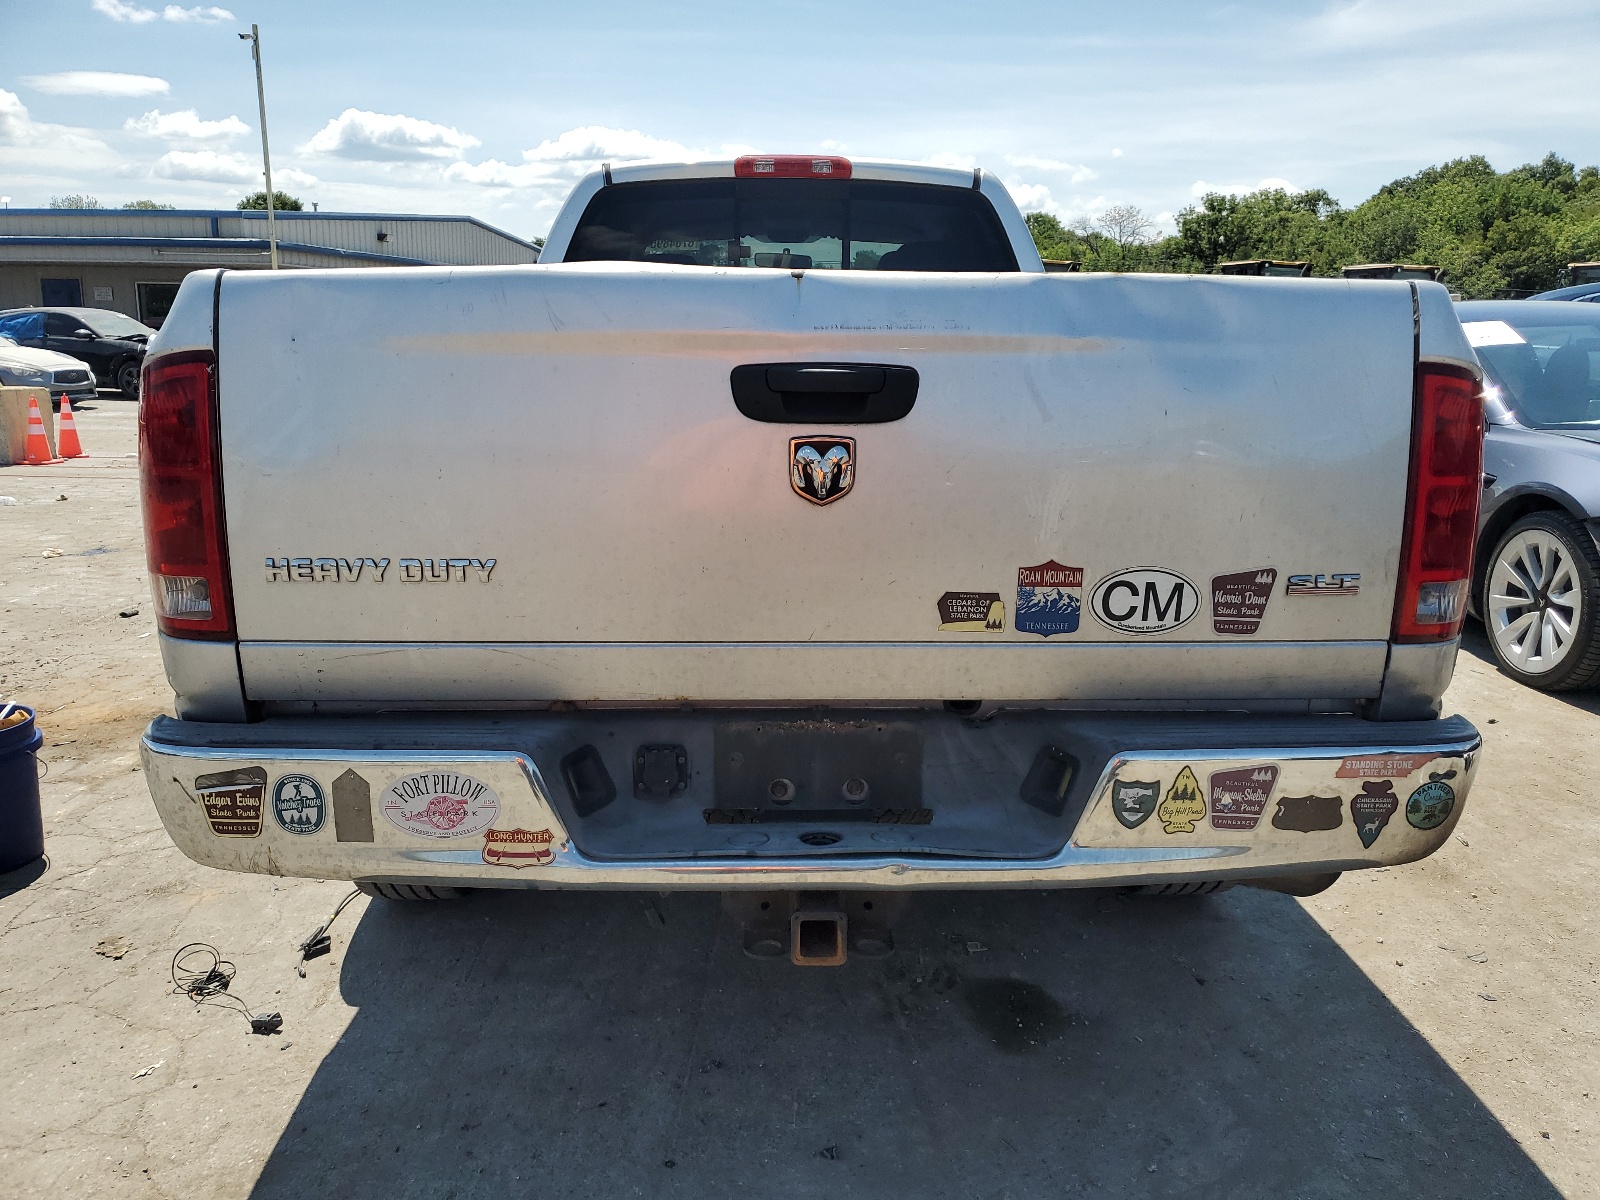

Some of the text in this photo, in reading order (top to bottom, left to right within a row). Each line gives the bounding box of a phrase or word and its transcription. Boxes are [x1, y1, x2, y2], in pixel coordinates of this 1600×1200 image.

[264, 557, 498, 583] HEAVY DUTY
[1019, 569, 1082, 586] ROAN MOUNTAIN
[1287, 573, 1361, 589] SLT
[1102, 580, 1184, 622] CM
[1214, 590, 1267, 605] Norris Dam
[979, 599, 991, 607] OF
[949, 605, 987, 613] LEBANON
[1217, 606, 1260, 616] State Park
[1025, 621, 1069, 630] TENNESSEE
[1345, 760, 1414, 769] STANDING STONE
[1359, 768, 1397, 776] STATE PARK
[392, 774, 488, 804] FORT PILLOW
[1416, 783, 1451, 797] PANTHER
[203, 792, 260, 808] Edgar Evins
[301, 797, 321, 808] Trace
[1240, 802, 1260, 812] Park
[210, 808, 257, 817] State Park
[1162, 806, 1174, 820] Big
[1174, 805, 1188, 817] Hill
[1187, 806, 1204, 816] Pond
[1214, 818, 1255, 826] TENNESSEE
[490, 832, 513, 841] LONG
[514, 831, 549, 841] HUNTER
